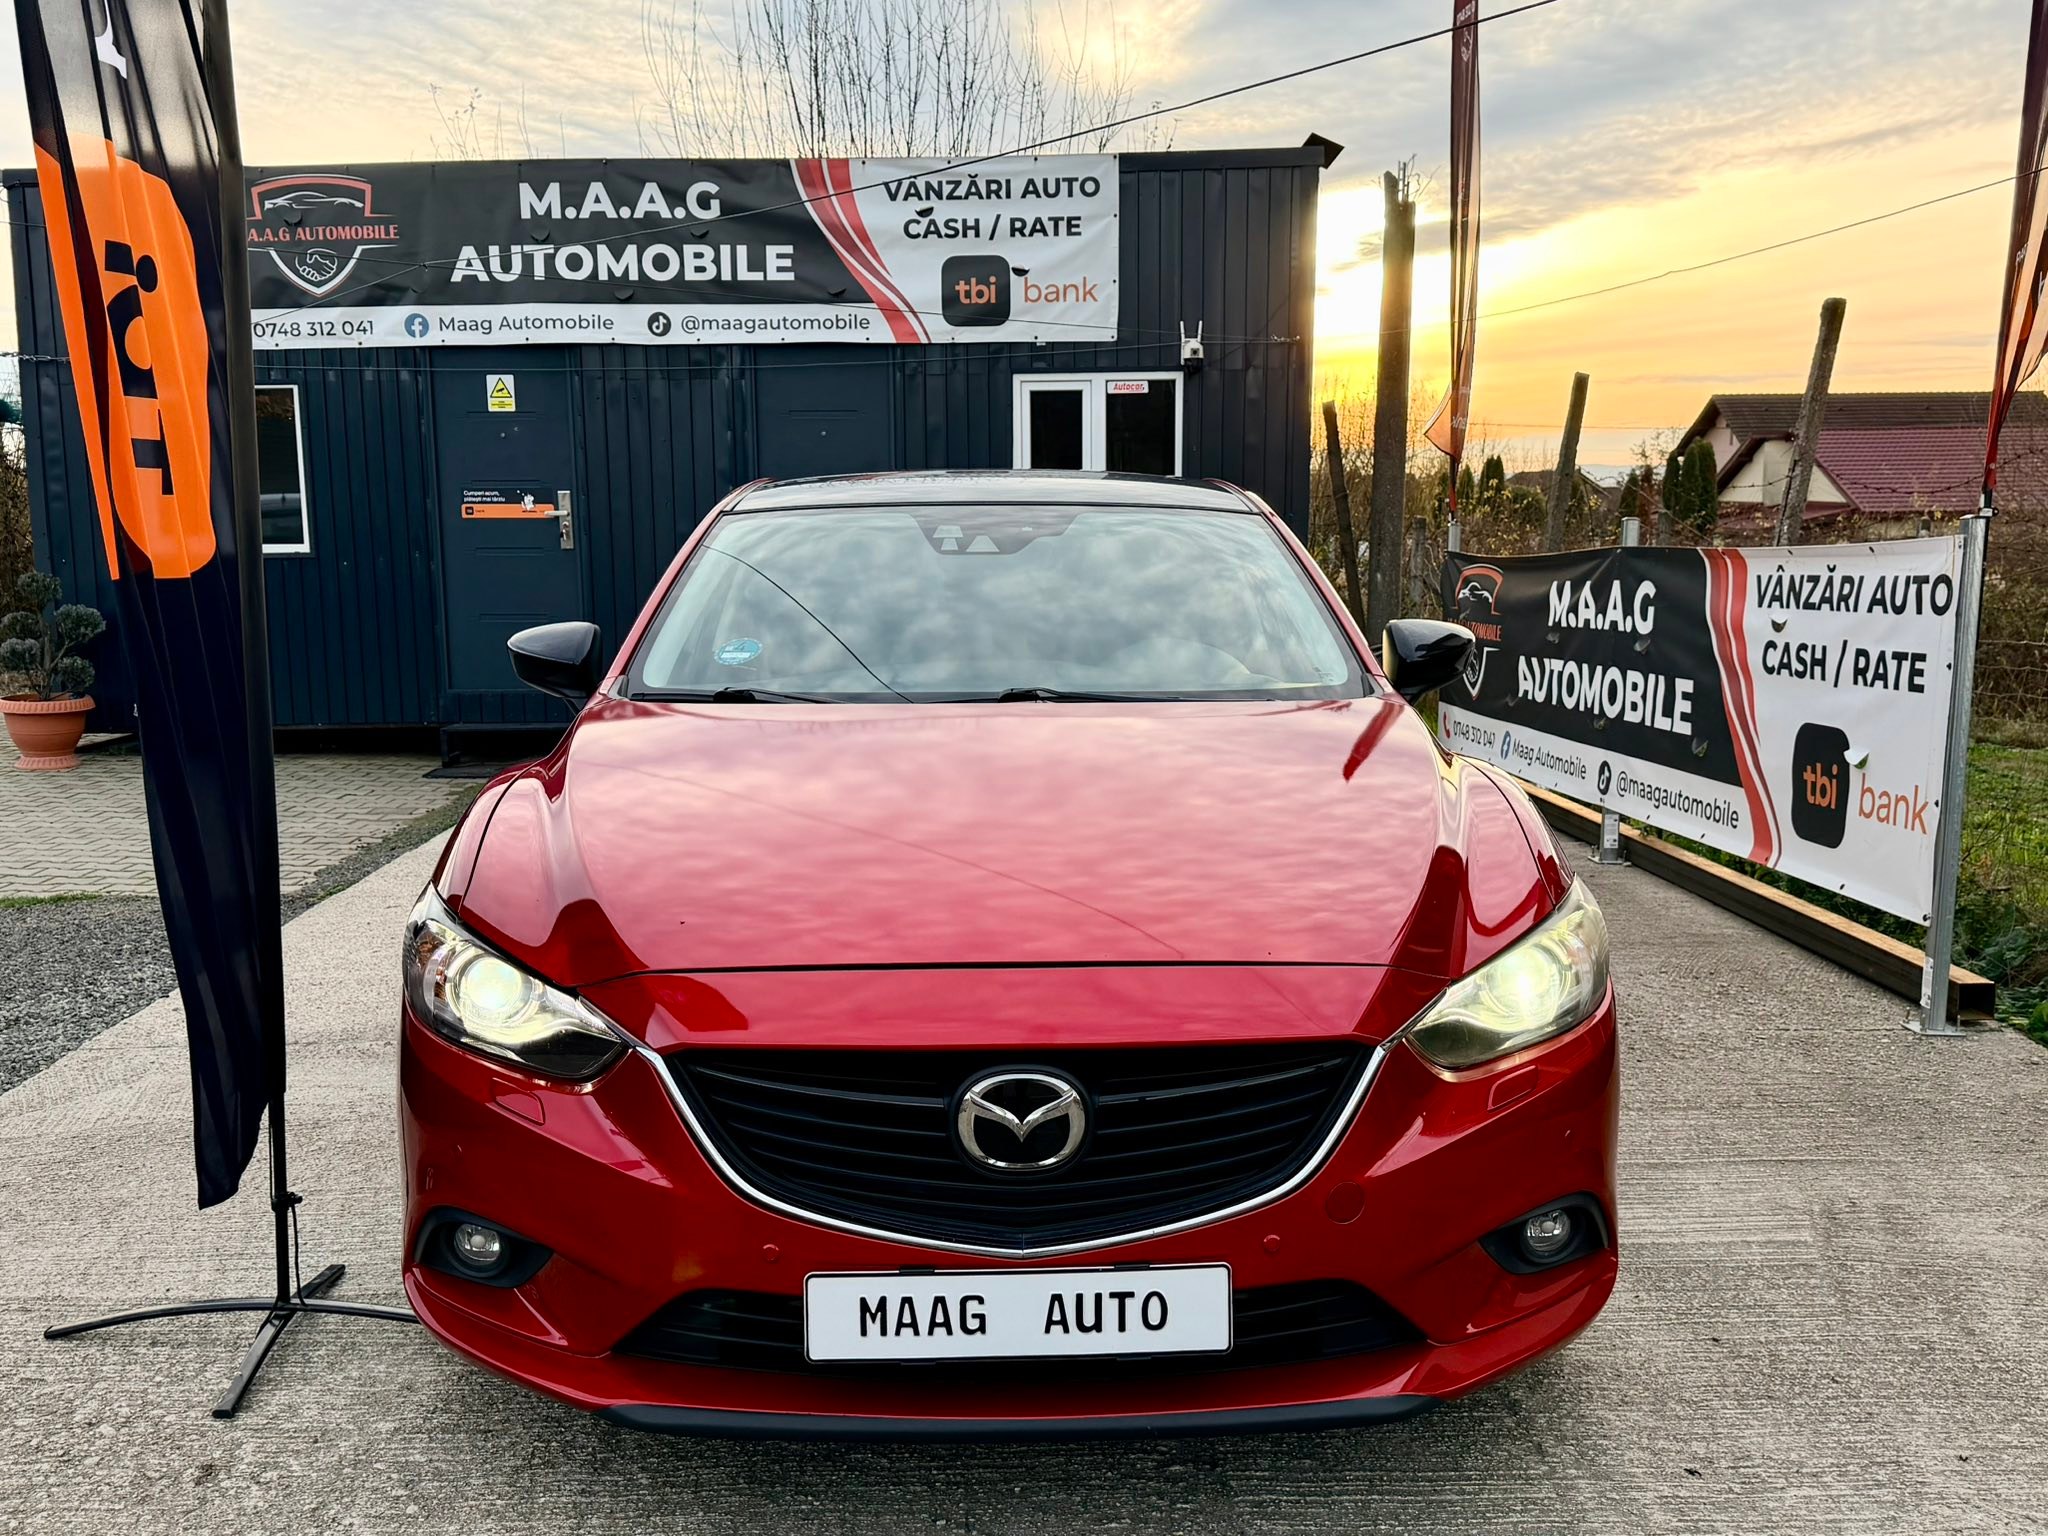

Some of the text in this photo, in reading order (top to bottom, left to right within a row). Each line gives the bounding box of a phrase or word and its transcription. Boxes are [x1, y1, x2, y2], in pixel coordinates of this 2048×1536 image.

[518, 181, 721, 220] M.A.A.G
[883, 173, 1101, 202] VÂNZĂRI AUTO
[295, 225, 399, 241] AUTOMOBILE
[903, 214, 1082, 241] CASH / RATE
[450, 243, 795, 283] AUTOMOBILE
[954, 276, 1099, 305] tbi bank
[253, 320, 373, 338] 0748 312 041
[439, 314, 614, 335] Maag Automobile
[681, 314, 870, 334] @maagautomobile
[1548, 579, 1656, 635] M.A.A.G
[1756, 564, 1953, 616] VÂNZĂRI AUTO
[1762, 639, 1927, 694] CASH / RATE
[1517, 655, 1694, 735] AUTOMOBILE
[1453, 720, 1469, 740] 0748
[1471, 725, 1482, 744] 312
[1512, 738, 1587, 780] Maag Automobile
[1616, 770, 1739, 829] @maagautomobile
[1803, 763, 1929, 834] tbi bank
[859, 1291, 1168, 1337] MAAG AUTO
